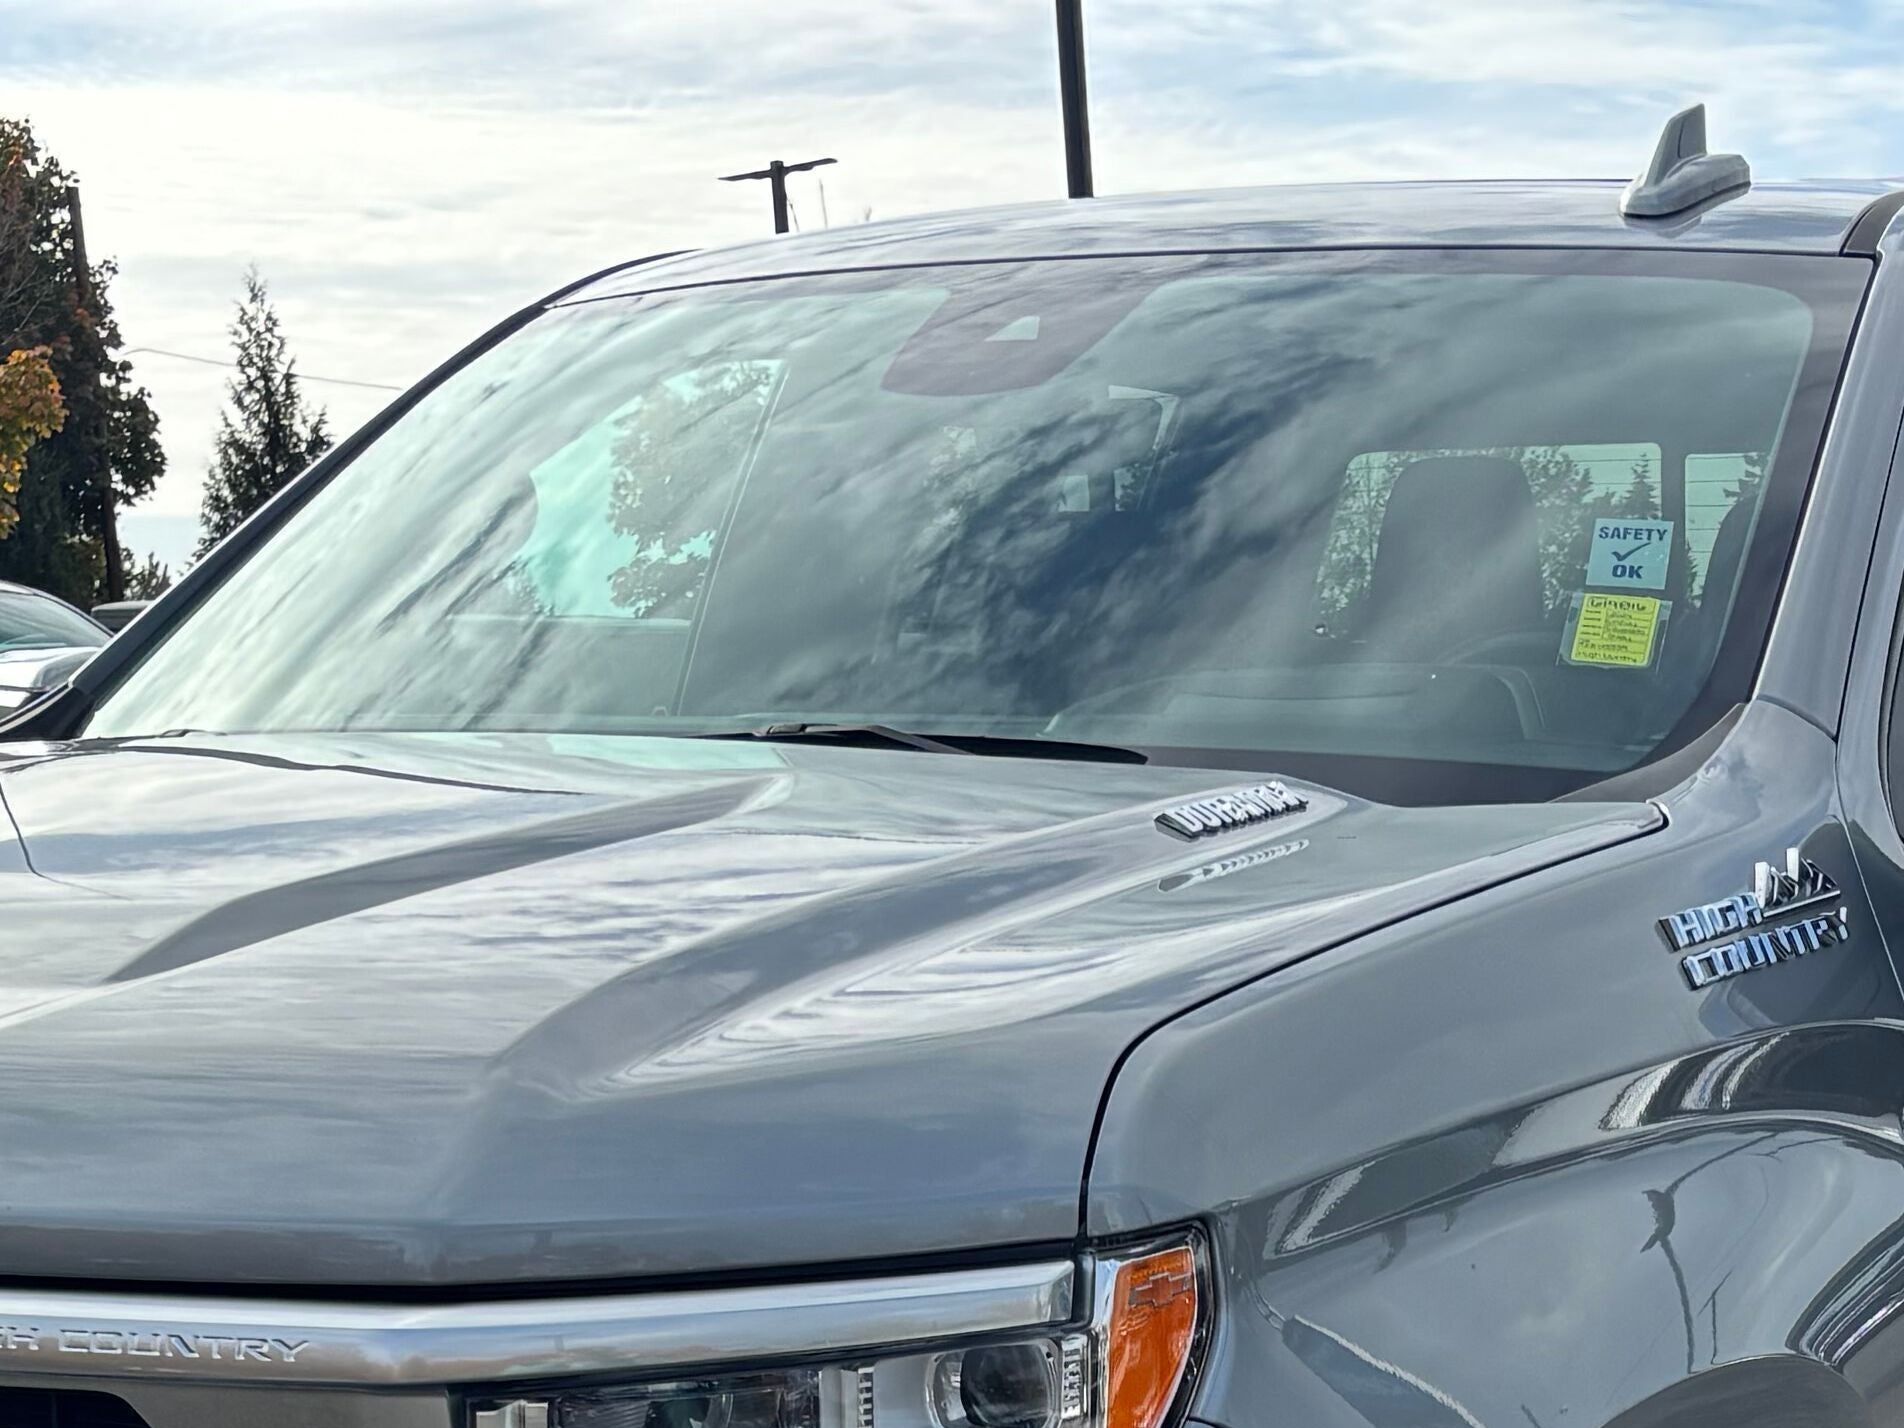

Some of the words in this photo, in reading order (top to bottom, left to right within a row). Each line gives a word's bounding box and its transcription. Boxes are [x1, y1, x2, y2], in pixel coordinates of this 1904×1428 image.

[1598, 526, 1668, 542] SAFETY
[1612, 564, 1644, 579] OK
[1659, 892, 1764, 950] HIGH
[1681, 906, 1848, 990] COUNTRY
[58, 1328, 310, 1363] COUNTRY
